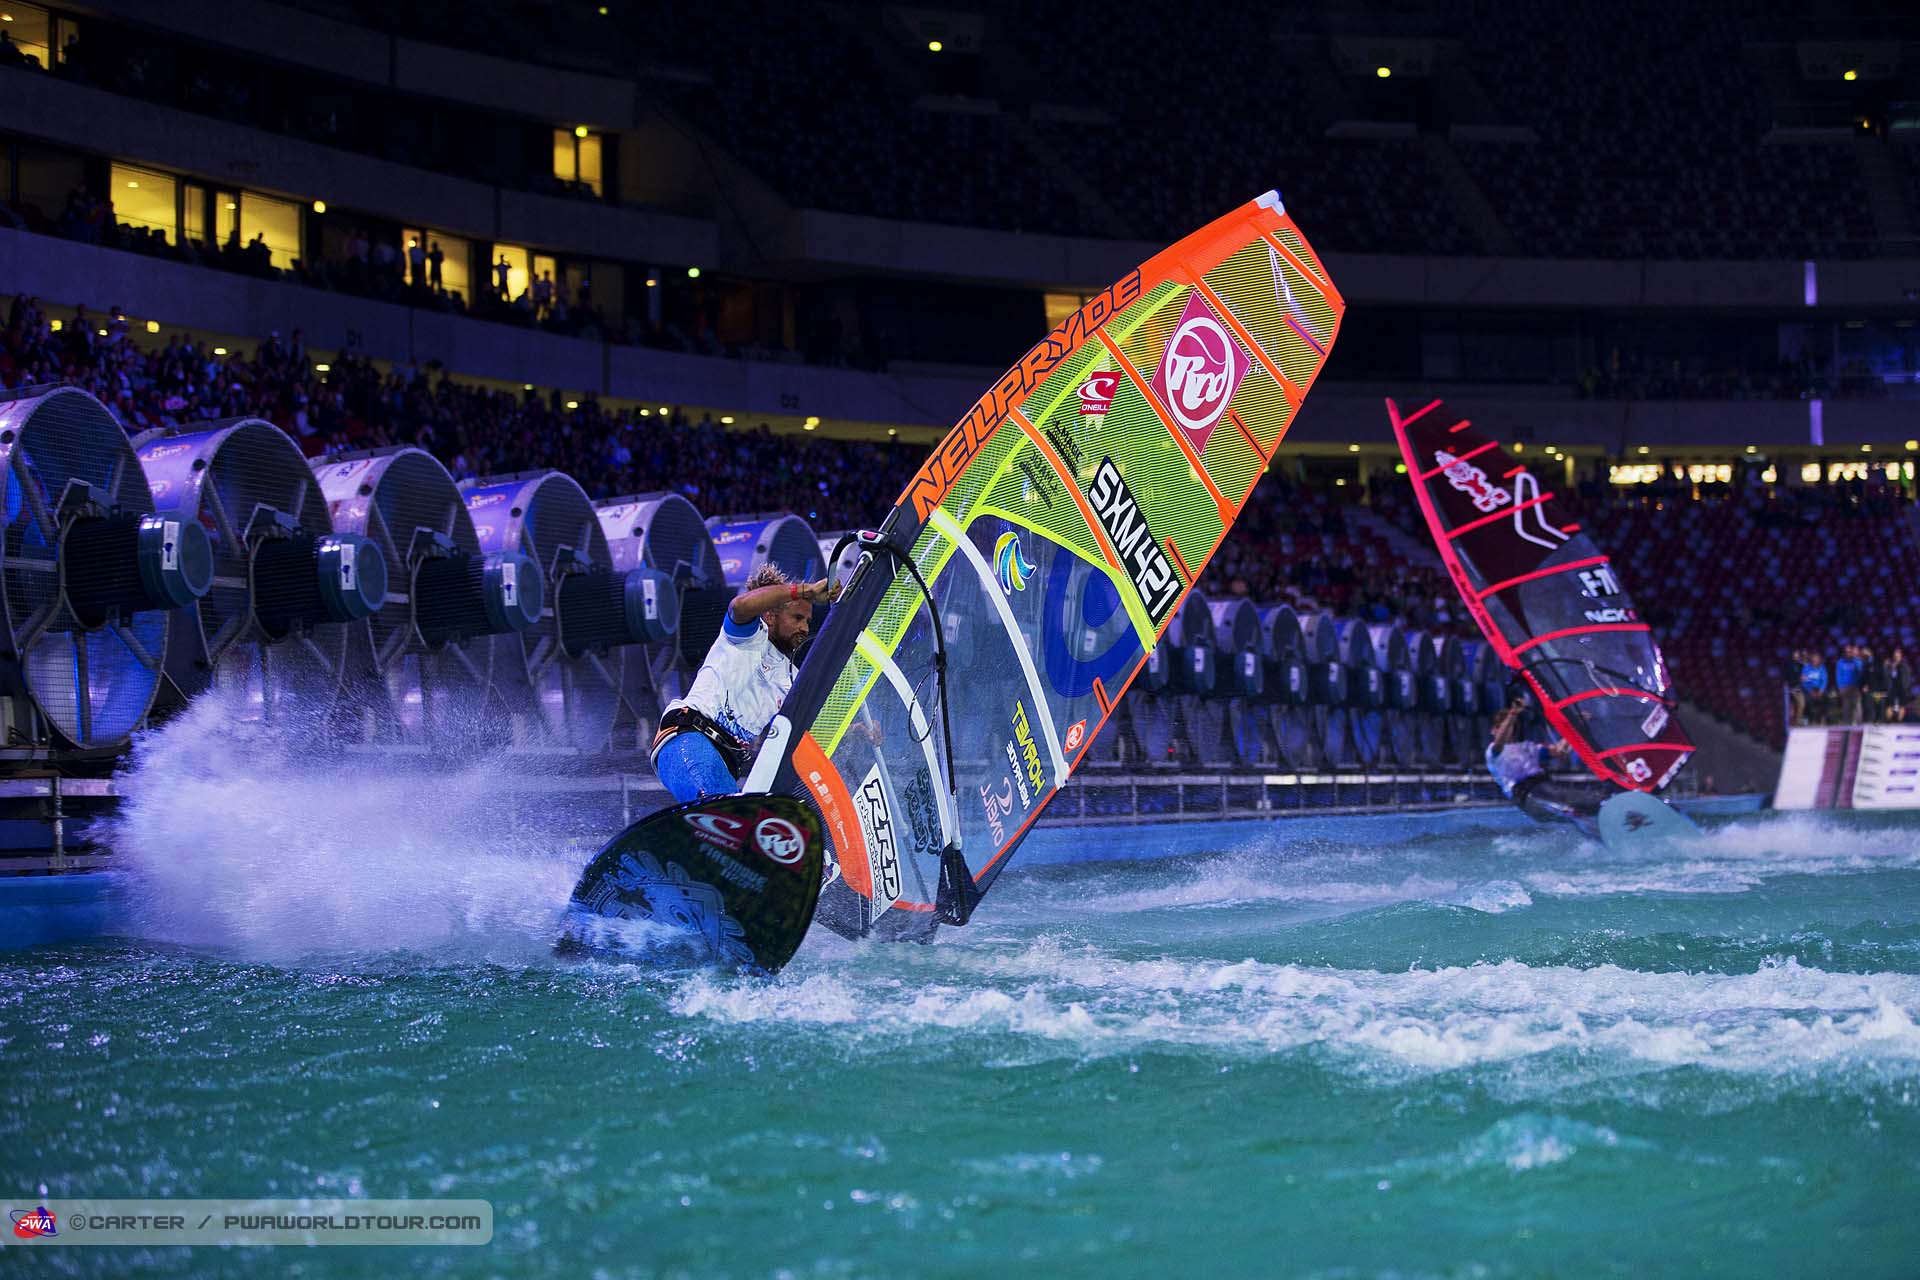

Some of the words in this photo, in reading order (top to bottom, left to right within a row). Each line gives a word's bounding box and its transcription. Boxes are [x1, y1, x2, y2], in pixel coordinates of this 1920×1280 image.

[911, 267, 1141, 525] NEILPRYDE
[1089, 462, 1180, 618] SXM421
[863, 778, 901, 901] RRD
